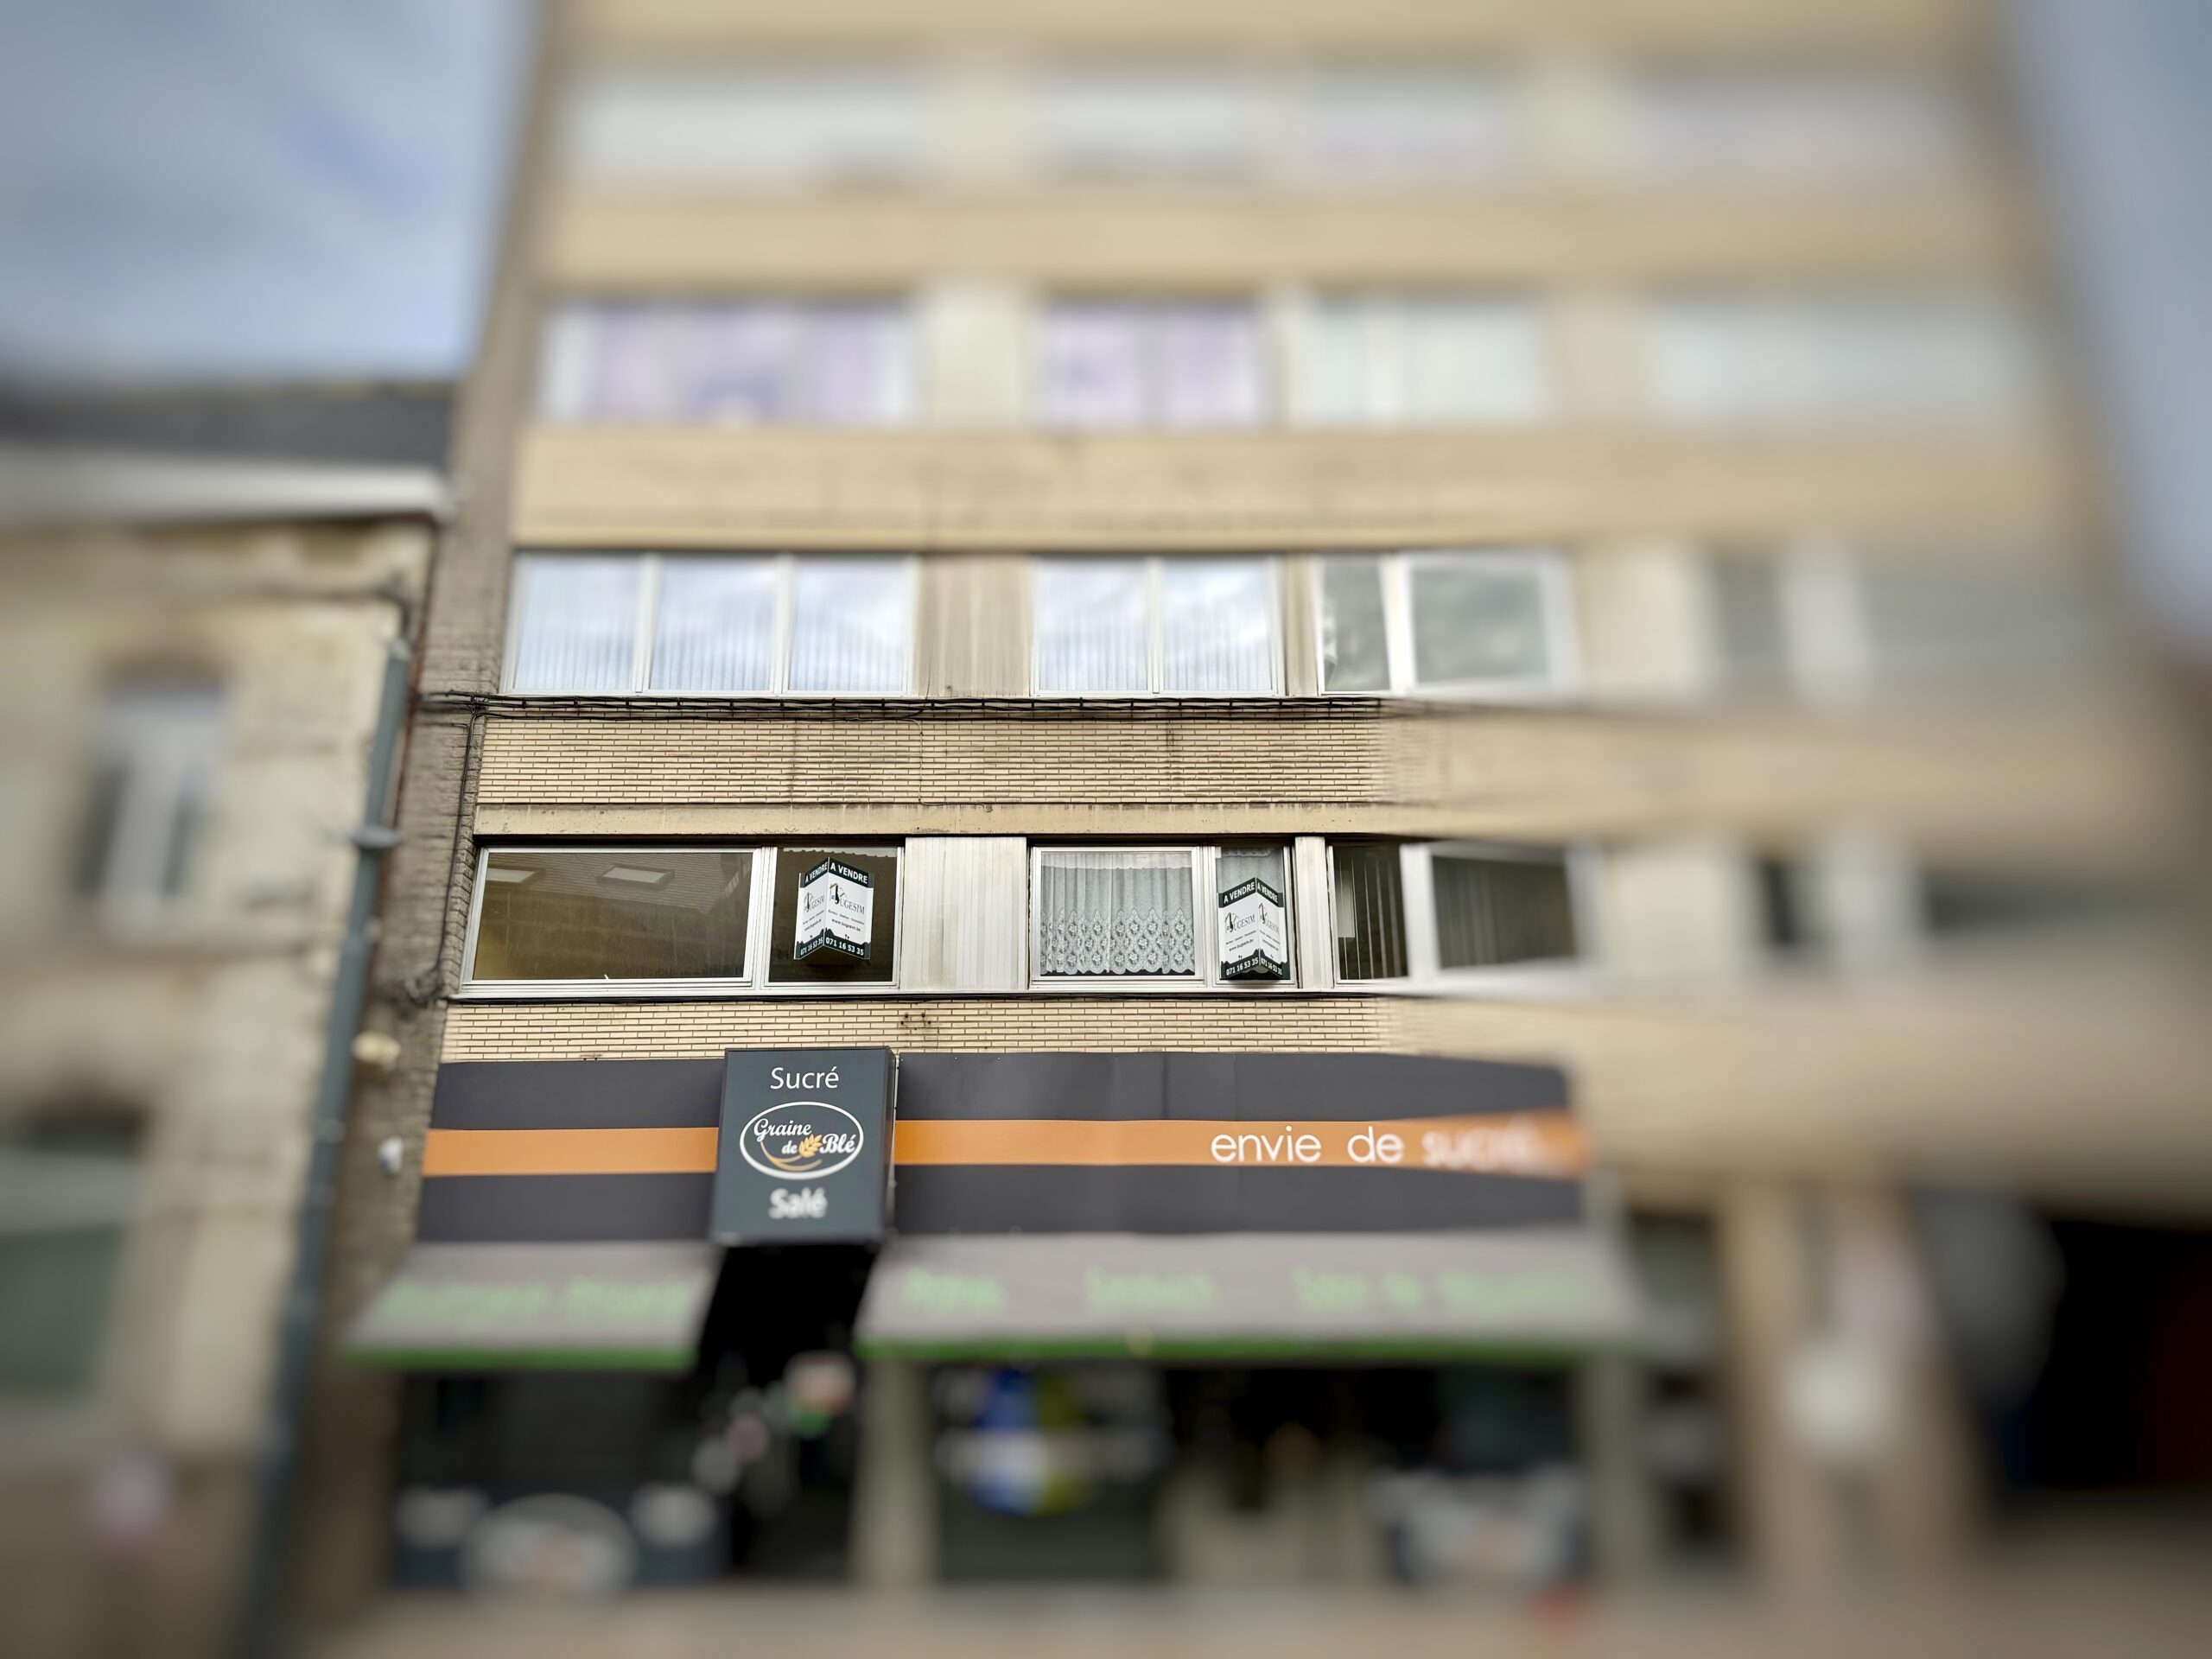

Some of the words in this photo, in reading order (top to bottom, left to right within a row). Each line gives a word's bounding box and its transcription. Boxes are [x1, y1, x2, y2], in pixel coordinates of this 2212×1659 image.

[805, 874, 809, 882] A
[810, 861, 828, 880] VENDRE
[838, 865, 868, 884] VENDRE
[1230, 881, 1255, 900] VENDRE
[1257, 881, 1261, 890] A
[1262, 885, 1278, 902] VENDRE
[826, 938, 837, 946] 071
[1226, 966, 1235, 976] 071
[1237, 963, 1243, 972] 16
[1244, 960, 1251, 969] 53
[1252, 957, 1259, 966] 35
[770, 1066, 839, 1090] Sucré
[753, 1119, 811, 1141] Graine
[781, 1141, 798, 1154] de
[820, 1134, 856, 1154] Blé
[1211, 1125, 1322, 1163] envie
[1346, 1126, 1405, 1164] de
